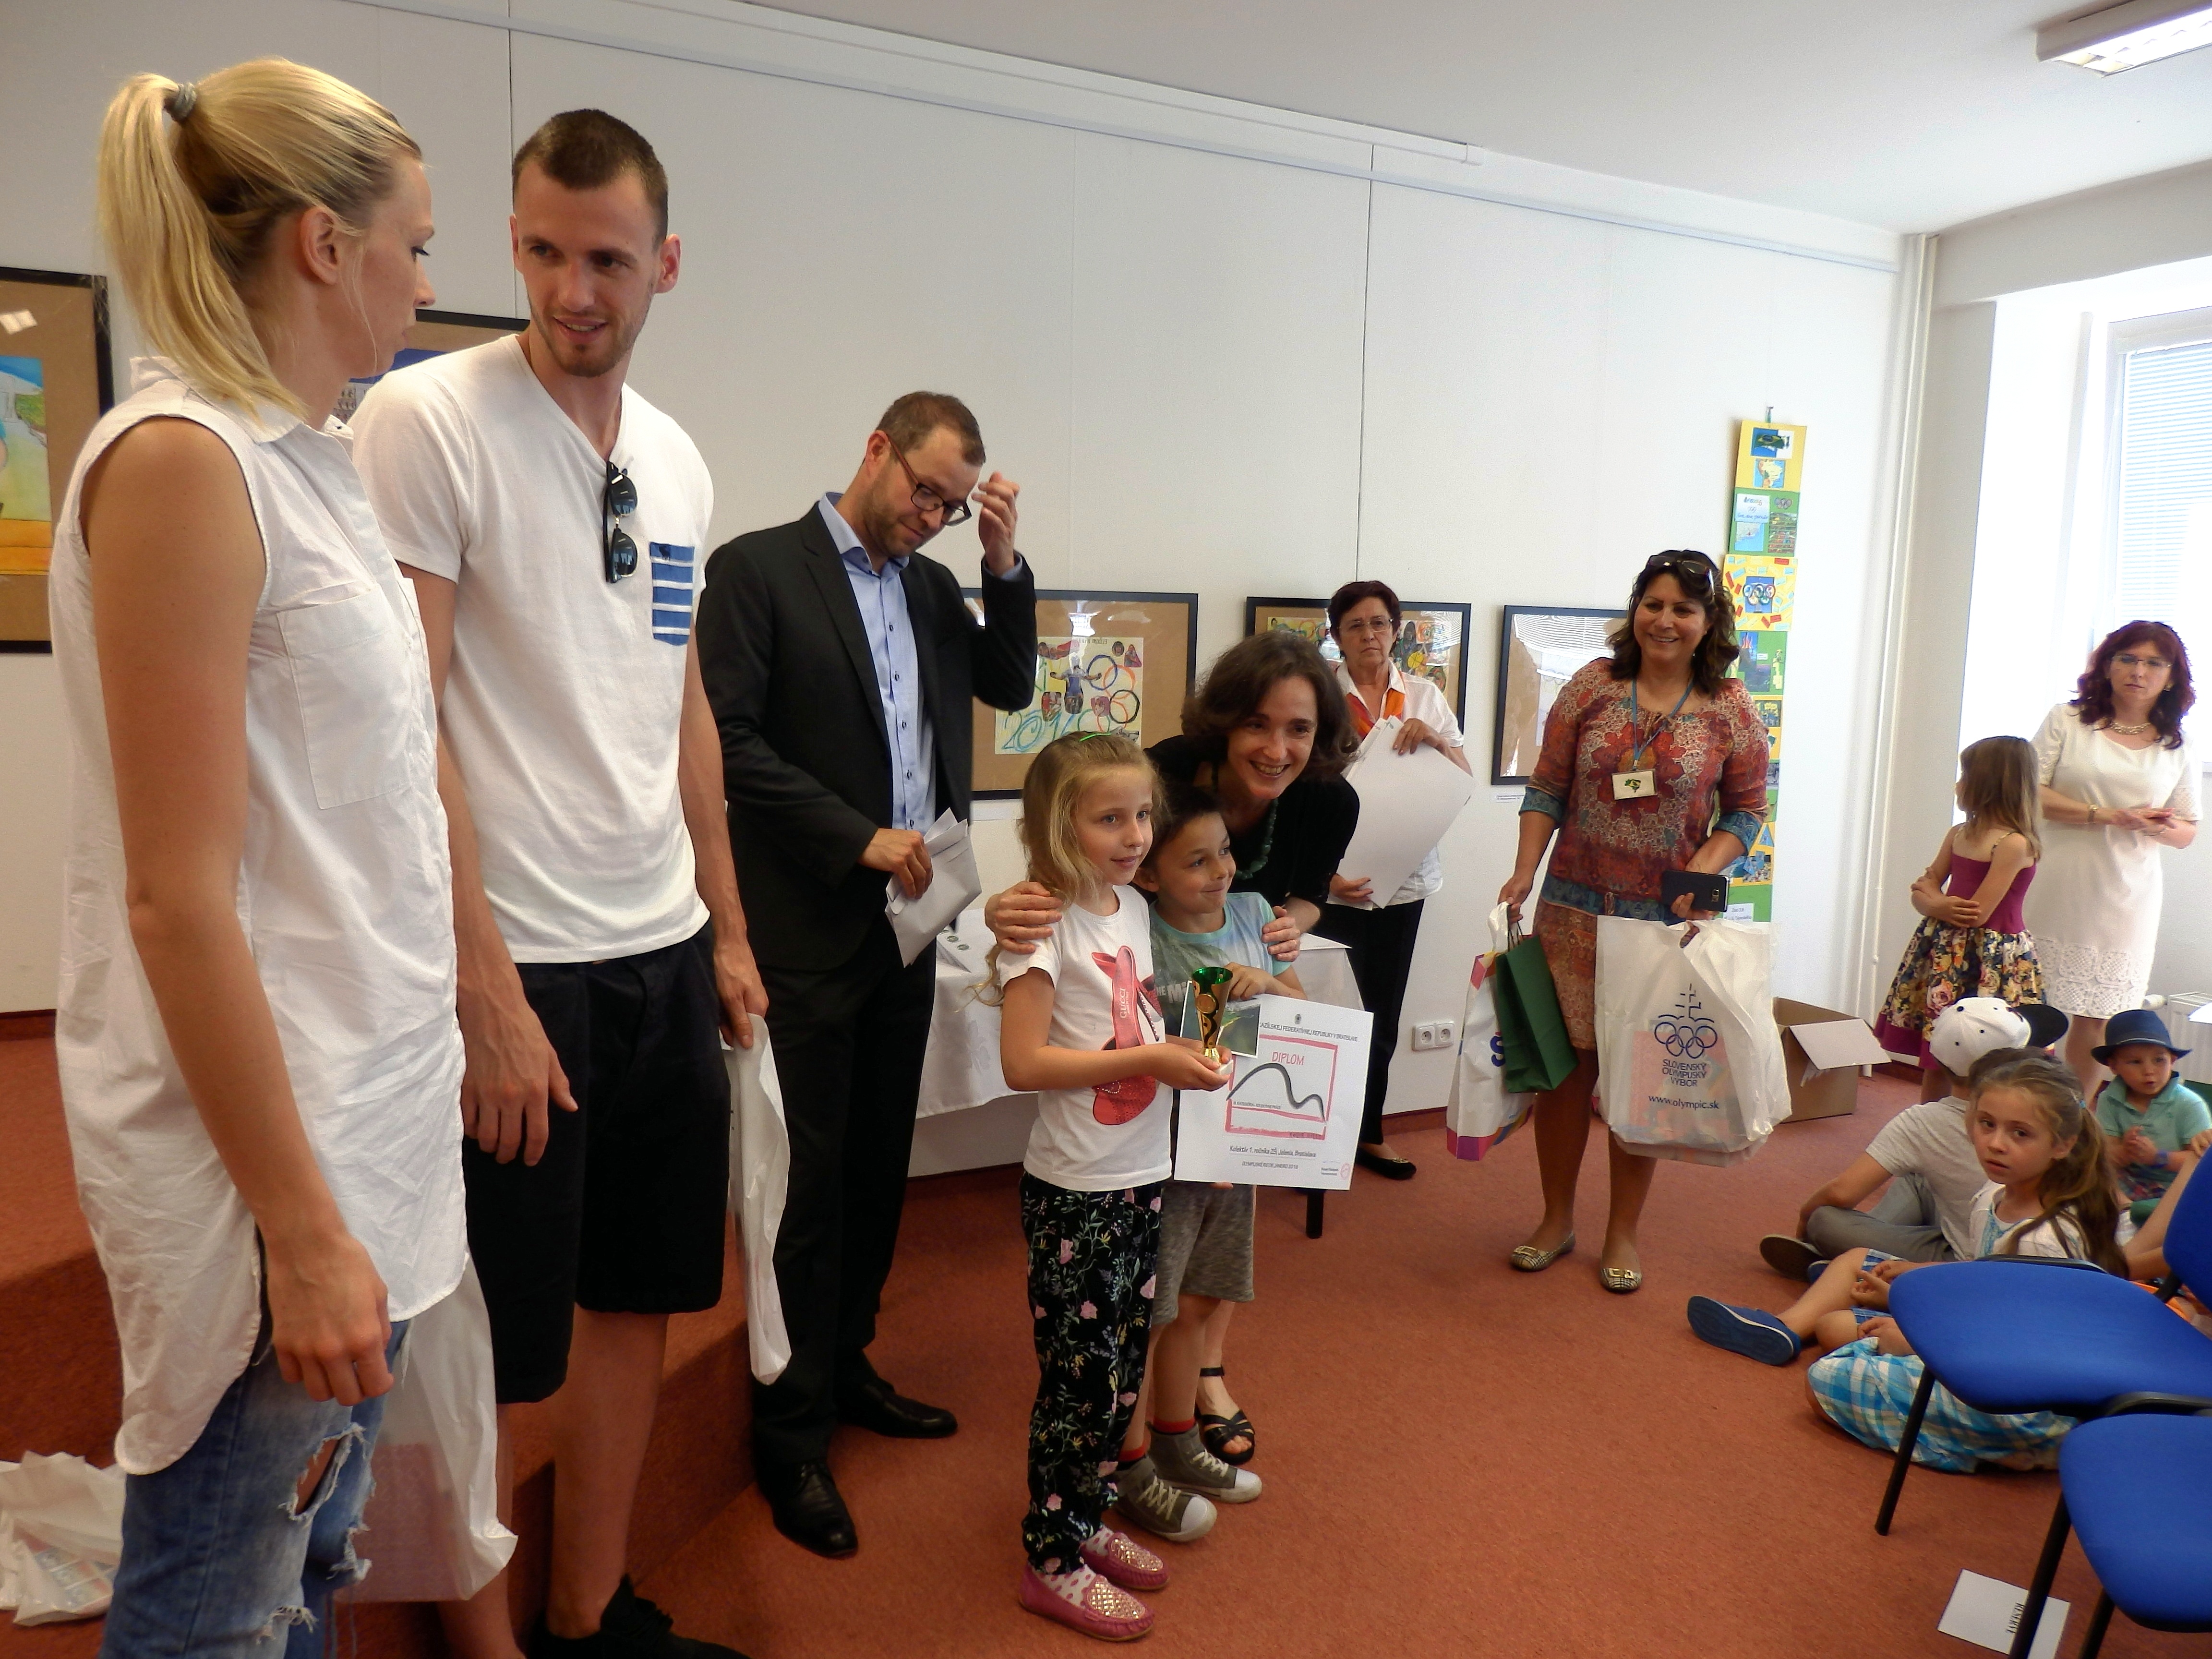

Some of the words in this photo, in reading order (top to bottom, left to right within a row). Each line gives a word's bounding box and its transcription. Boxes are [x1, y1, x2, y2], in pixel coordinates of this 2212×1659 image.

[1260, 1022, 1282, 1031] AZÍLSKEJ
[1272, 1051, 1305, 1066] DIPLOM
[1648, 1095, 1720, 1111] www.olympic.sk
